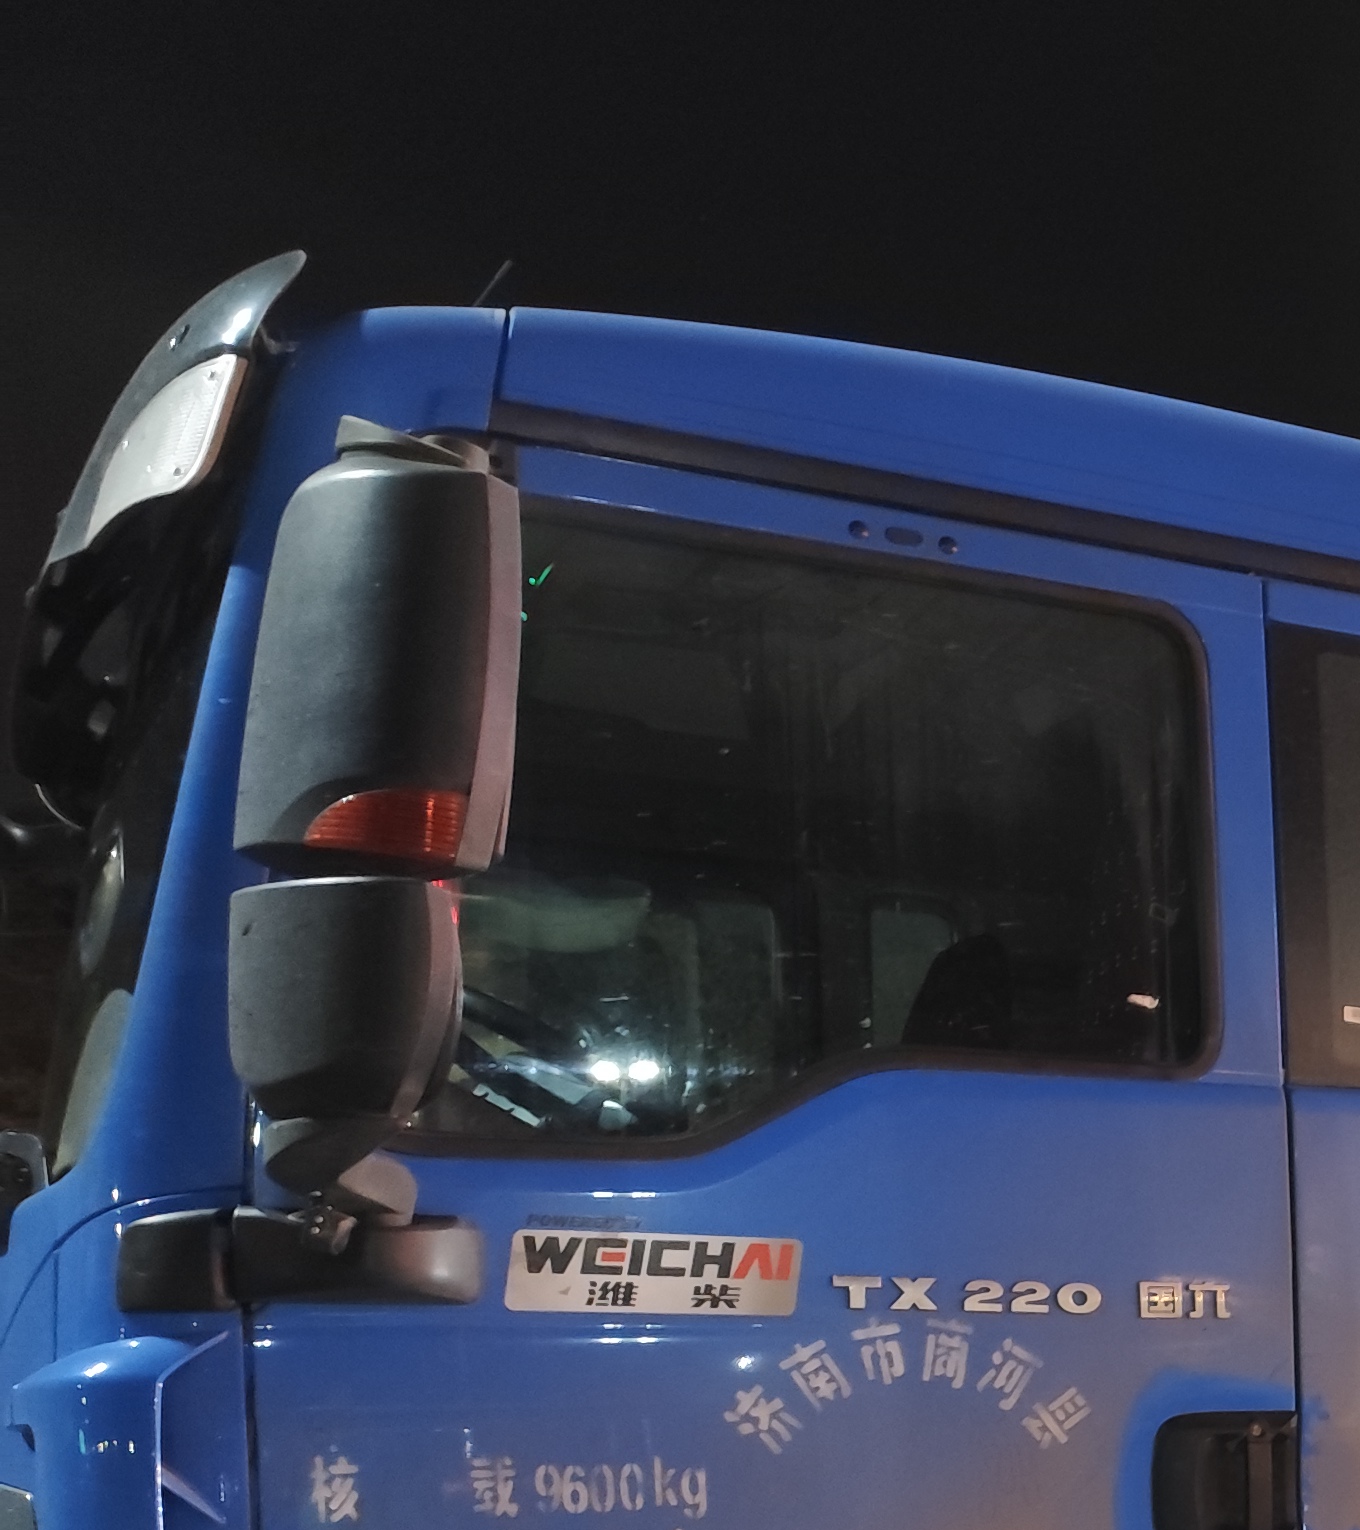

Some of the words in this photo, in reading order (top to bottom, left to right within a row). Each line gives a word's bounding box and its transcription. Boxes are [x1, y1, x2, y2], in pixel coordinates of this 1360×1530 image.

[522, 1235, 794, 1281] WEICHAI
[585, 1280, 742, 1309] 潍柴
[832, 1275, 938, 1310] TX
[963, 1279, 1102, 1314] 220
